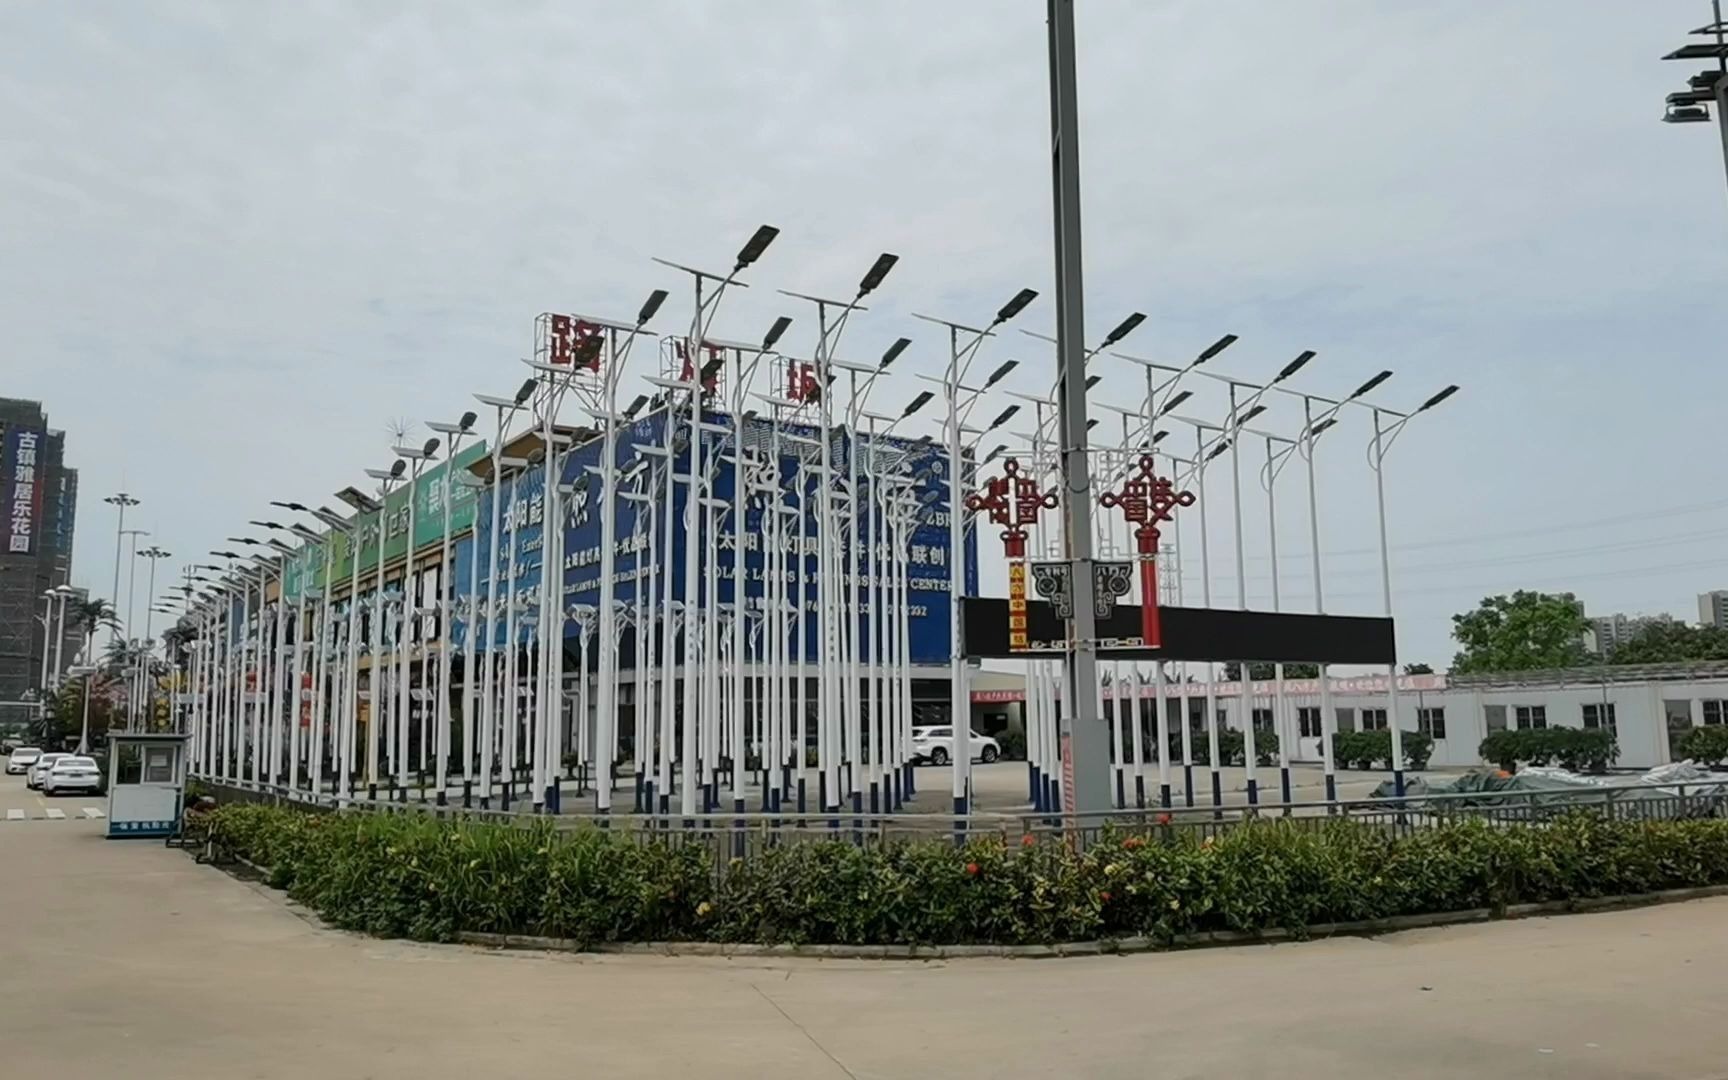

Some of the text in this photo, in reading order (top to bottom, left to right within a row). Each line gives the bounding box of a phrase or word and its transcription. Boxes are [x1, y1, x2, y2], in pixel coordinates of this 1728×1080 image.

[9, 431, 38, 553] 古镇雅居乐花园
